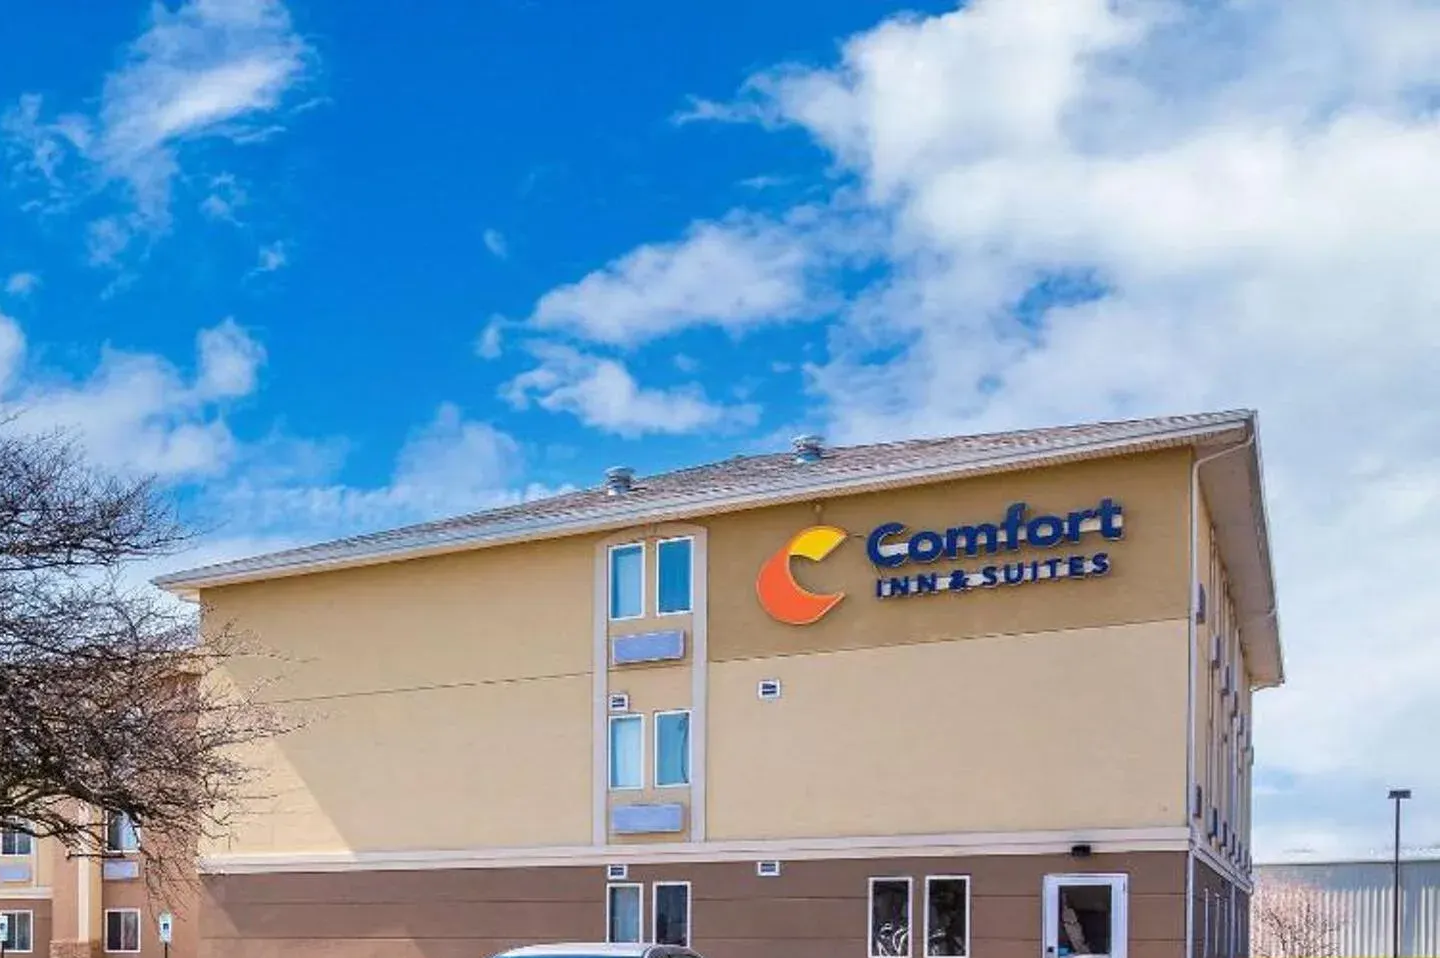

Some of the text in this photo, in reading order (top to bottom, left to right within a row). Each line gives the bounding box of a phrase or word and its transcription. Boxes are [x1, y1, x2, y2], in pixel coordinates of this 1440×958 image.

[867, 498, 1124, 568] Comfort
[877, 553, 1110, 599] INN & SUITES
